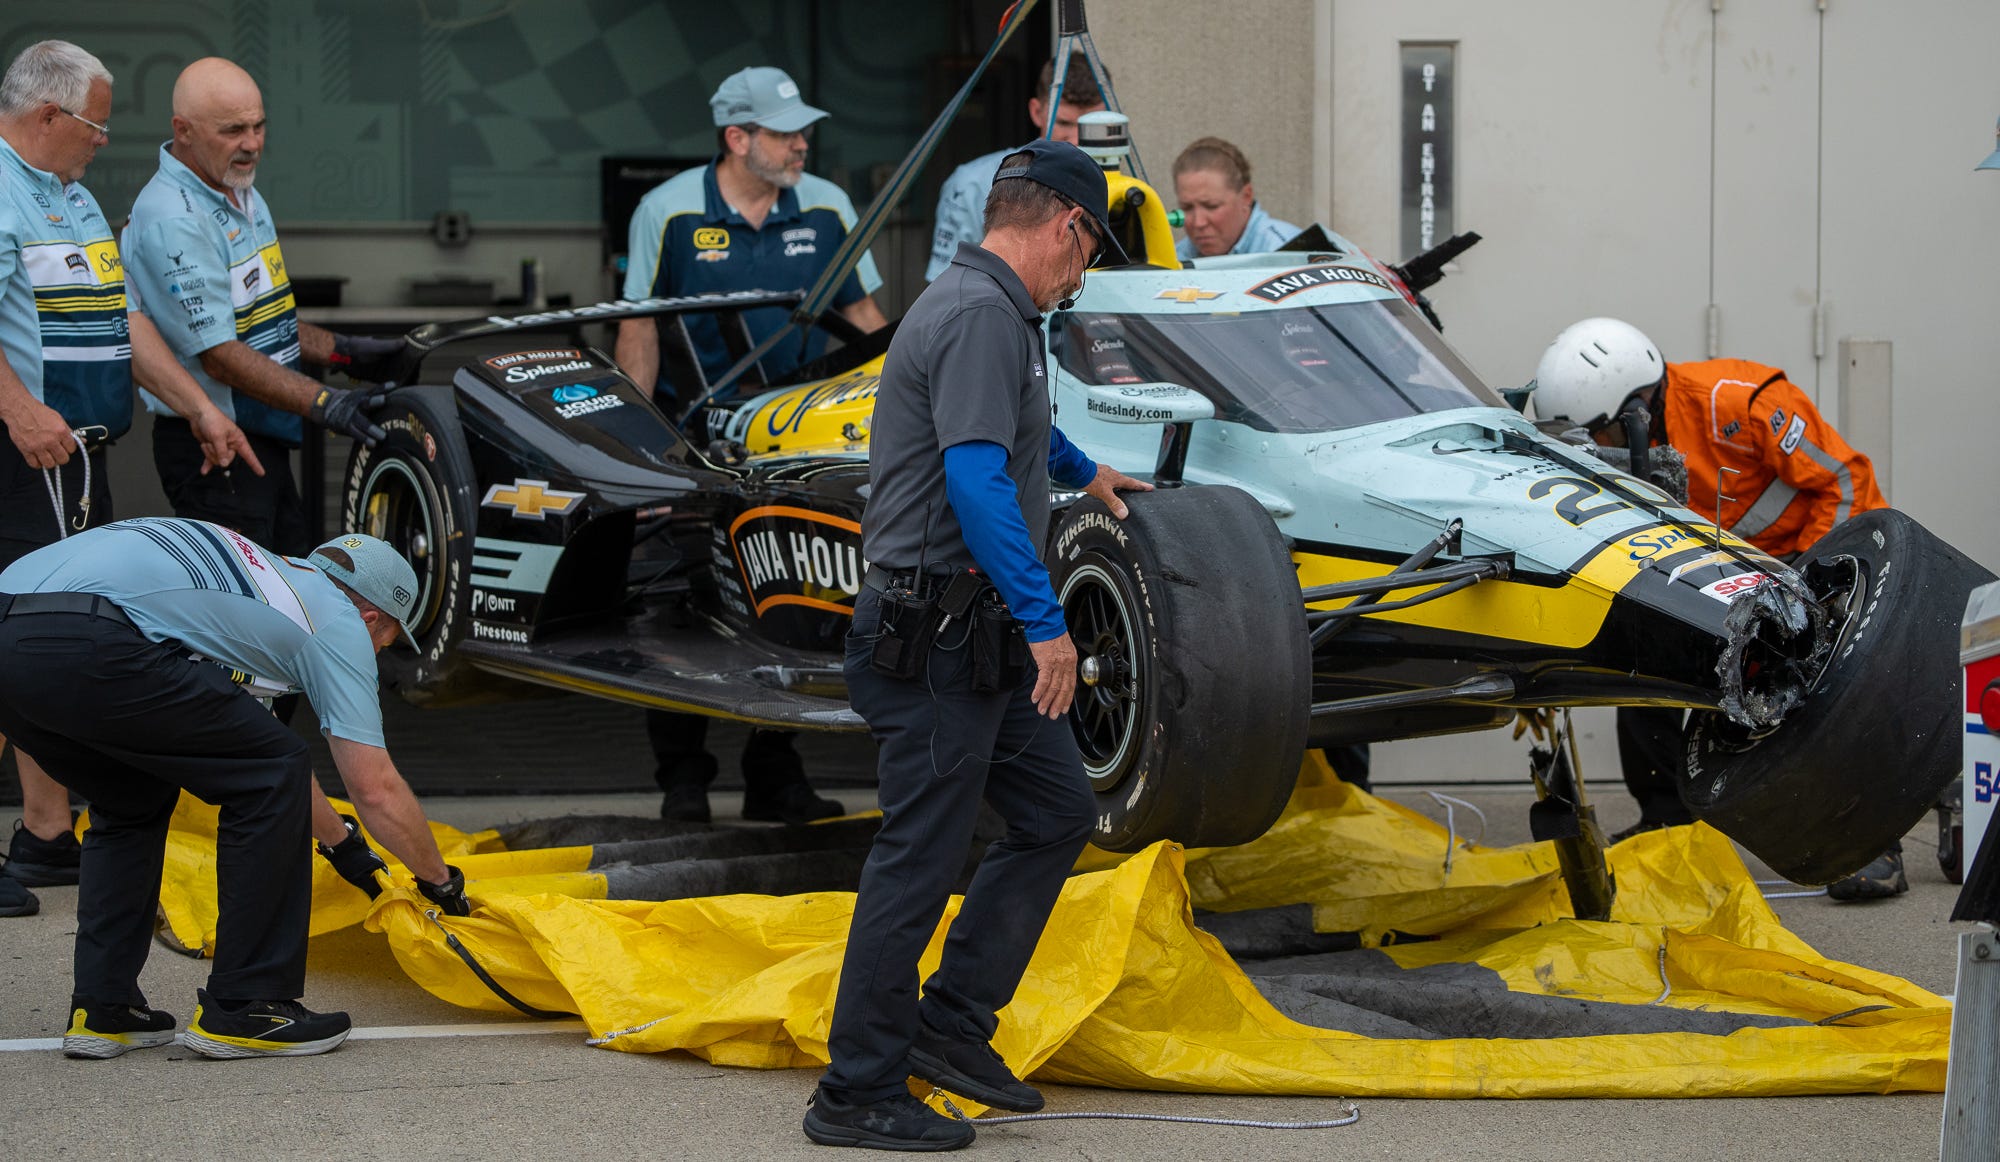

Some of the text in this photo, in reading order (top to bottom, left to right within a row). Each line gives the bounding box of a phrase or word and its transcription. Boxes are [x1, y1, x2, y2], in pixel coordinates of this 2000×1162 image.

[1421, 103, 1436, 132] AN
[1421, 142, 1435, 250] ENTRANCE
[1263, 268, 1388, 297] JAVA HOUSE
[1091, 340, 1125, 353] Splenda
[495, 351, 573, 366] JAVA HOUSE
[505, 361, 593, 383] Splenda
[554, 394, 619, 414] LIQUID
[562, 400, 625, 419] SCIENCE
[1087, 398, 1173, 420] BirdiesIndy.com
[1527, 472, 1686, 527] 20
[343, 537, 362, 548] 20
[1057, 512, 1129, 559] FIREHAWK
[741, 530, 789, 590] JAVA
[789, 531, 871, 596] HOU
[473, 621, 528, 643] Firestone
